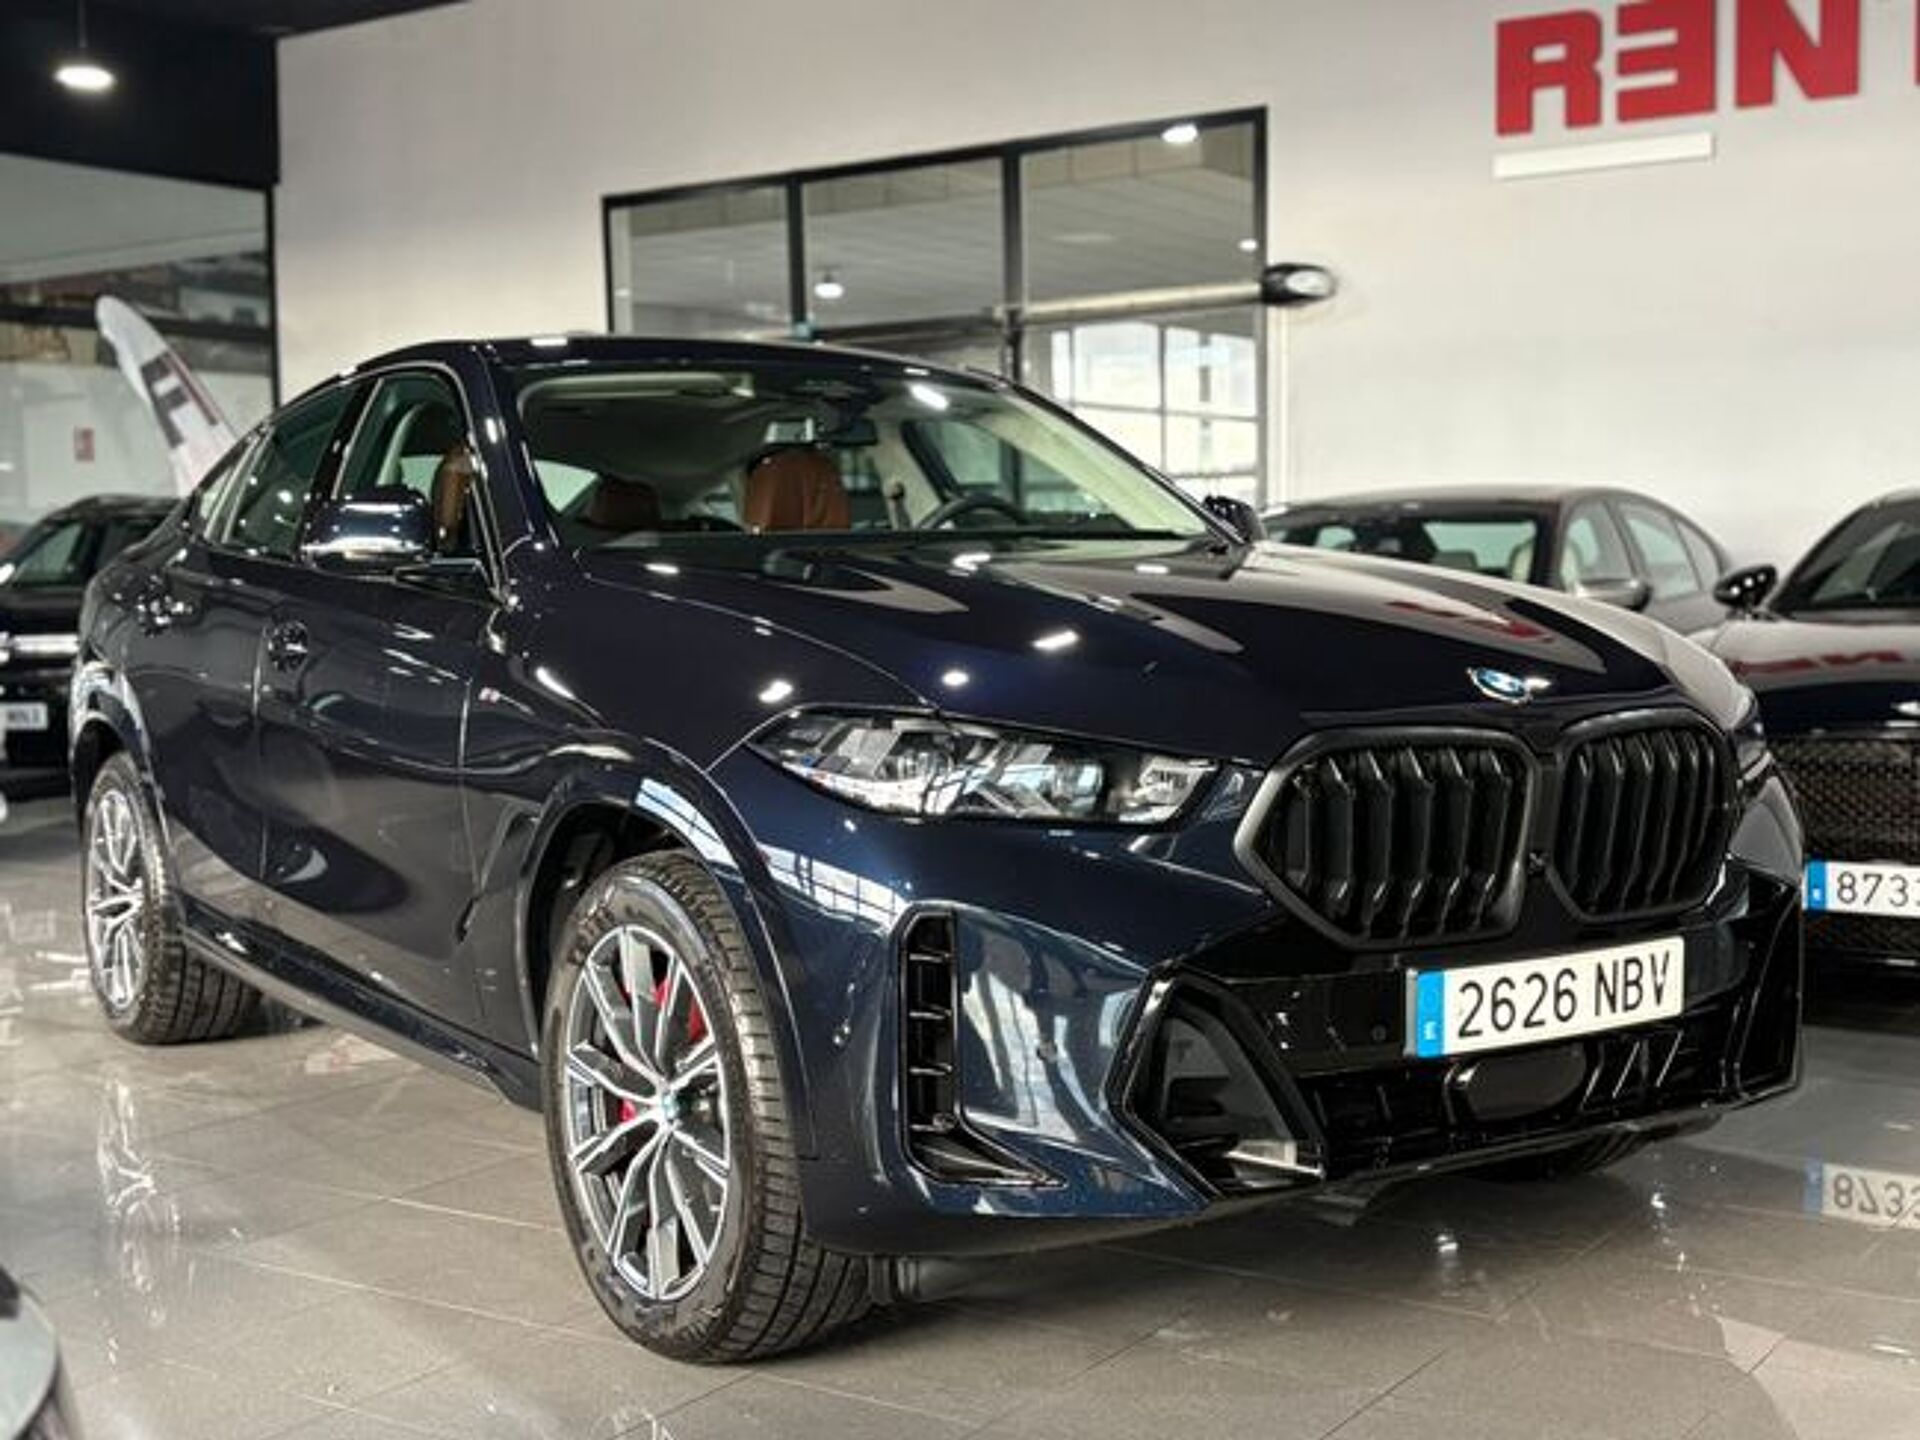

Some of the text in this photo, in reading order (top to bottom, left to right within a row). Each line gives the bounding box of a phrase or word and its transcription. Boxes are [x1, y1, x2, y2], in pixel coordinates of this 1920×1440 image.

[1495, 0, 1920, 136] REN
[1837, 871, 1920, 908] 873
[1457, 950, 1671, 1039] 2626 NBV
